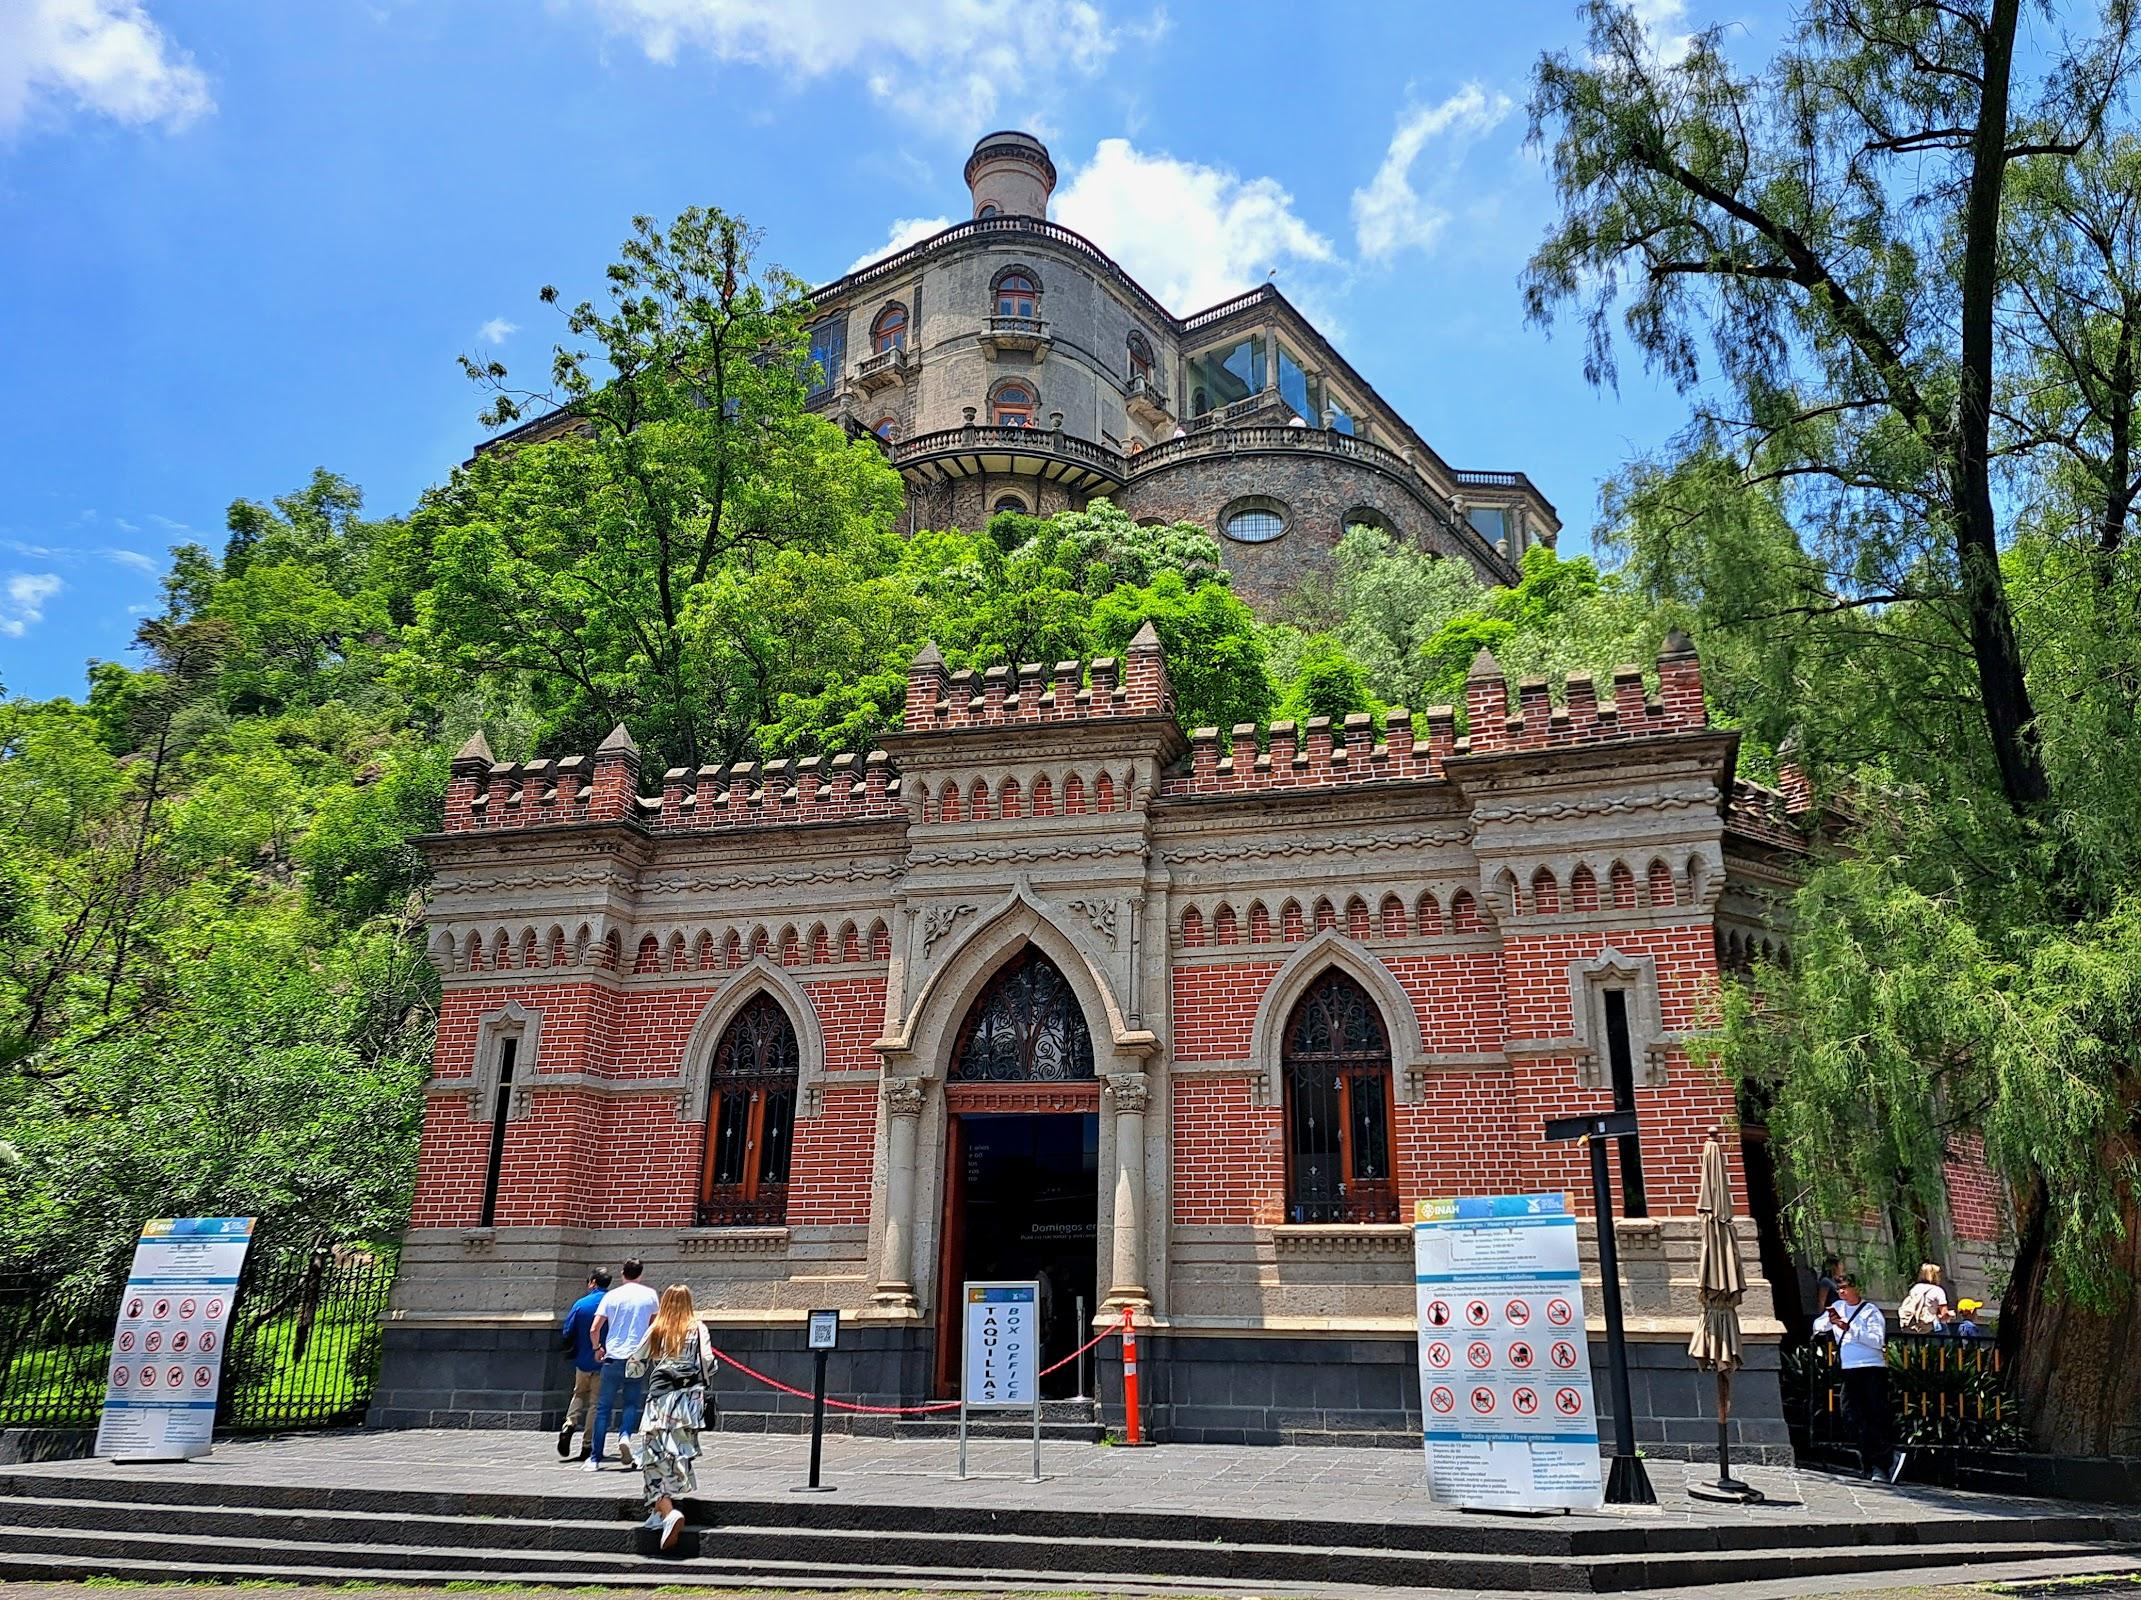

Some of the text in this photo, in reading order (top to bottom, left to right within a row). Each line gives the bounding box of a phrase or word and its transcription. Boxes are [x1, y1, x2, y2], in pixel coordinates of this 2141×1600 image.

[1031, 1223, 1082, 1234] Domingos
[1434, 1205, 1460, 1215] INAH
[983, 1307, 998, 1400] TAQUILLAS
[1007, 1307, 1020, 1399] BOX OFFICE
